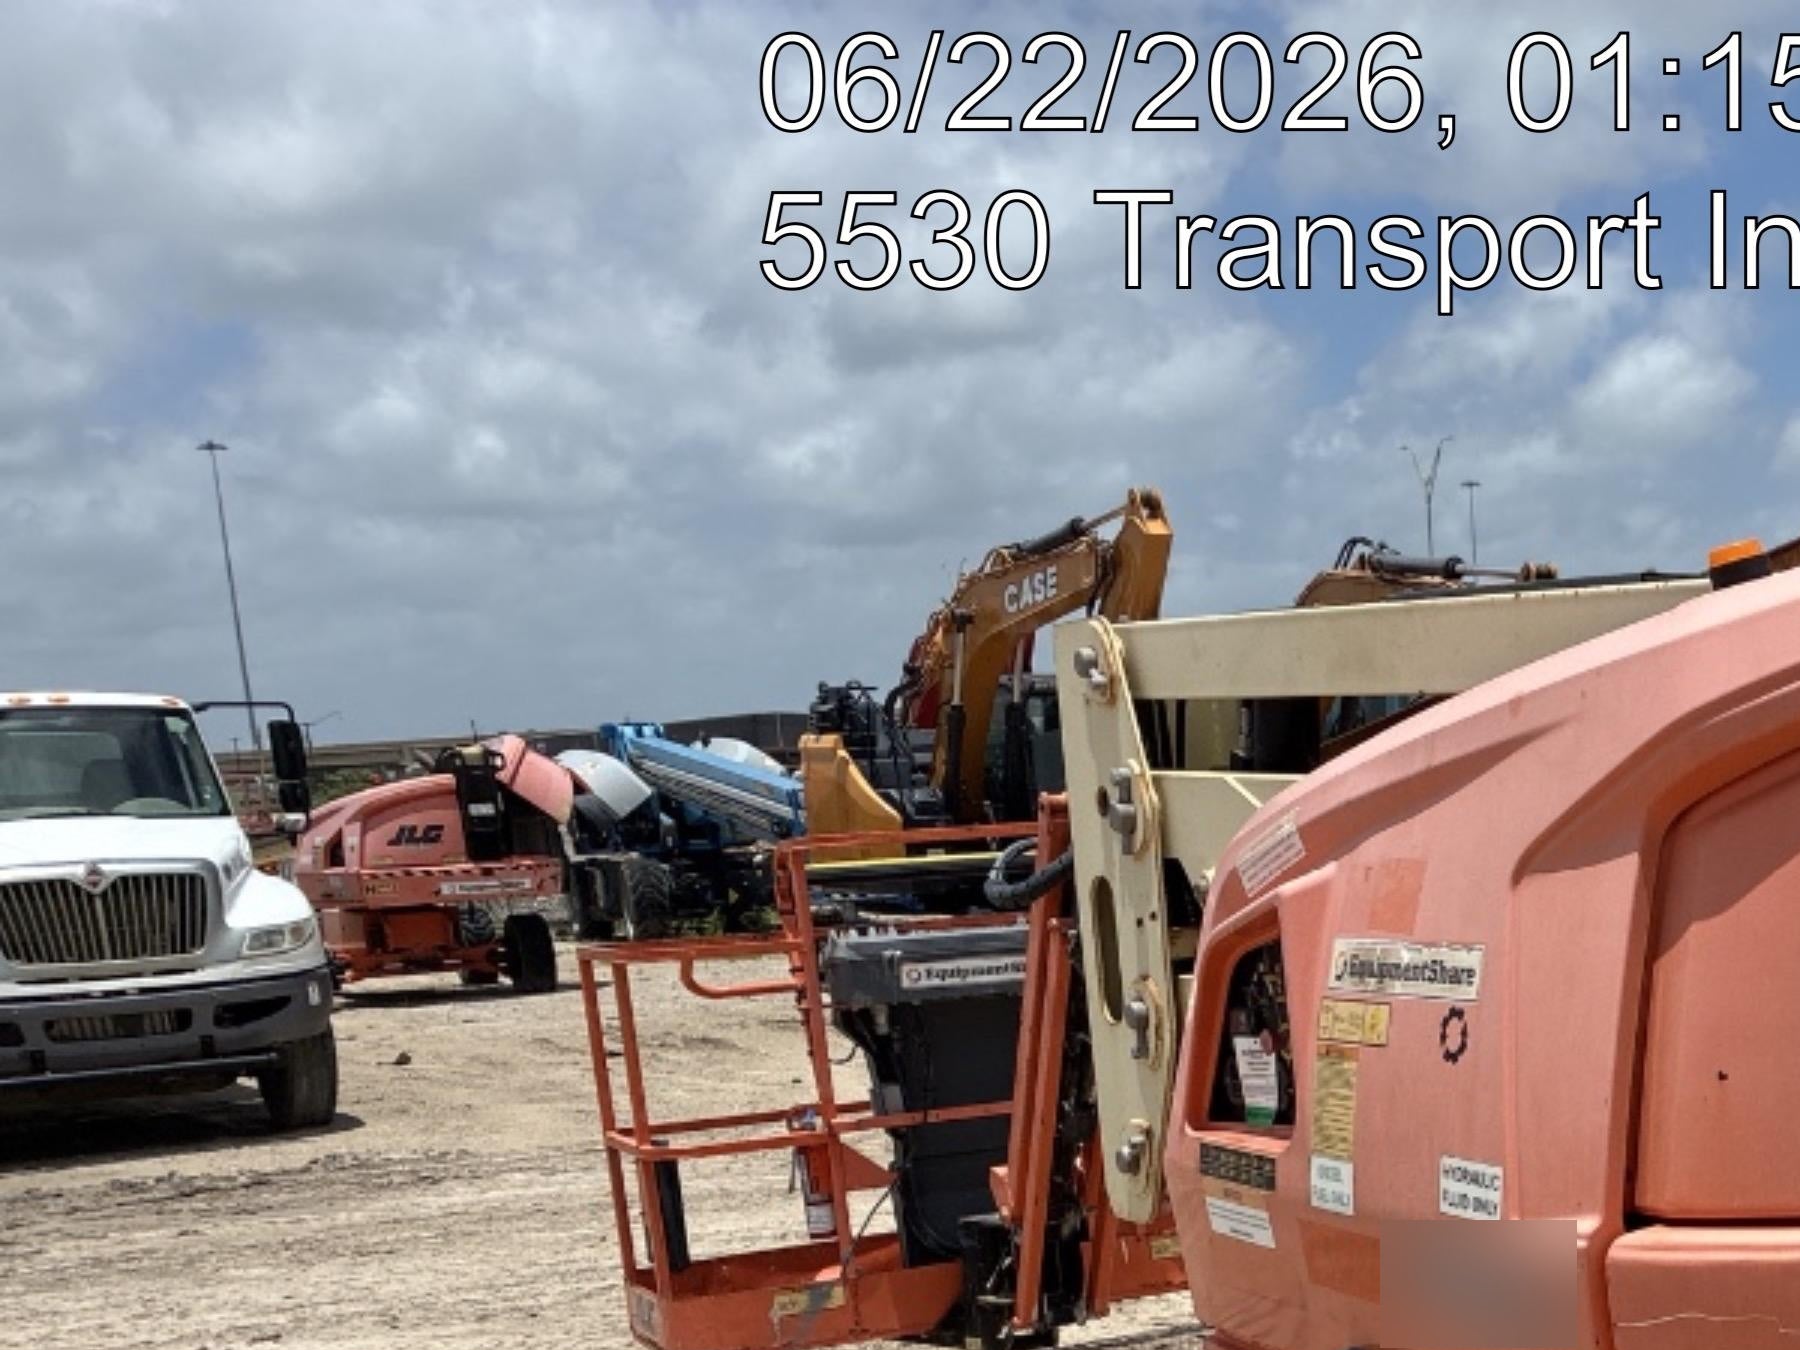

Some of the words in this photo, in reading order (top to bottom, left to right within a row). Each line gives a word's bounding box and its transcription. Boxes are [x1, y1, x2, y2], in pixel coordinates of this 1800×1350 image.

[1004, 565, 1057, 613] CASE
[386, 824, 445, 846] JLG
[1348, 953, 1477, 987] EquipmentShare
